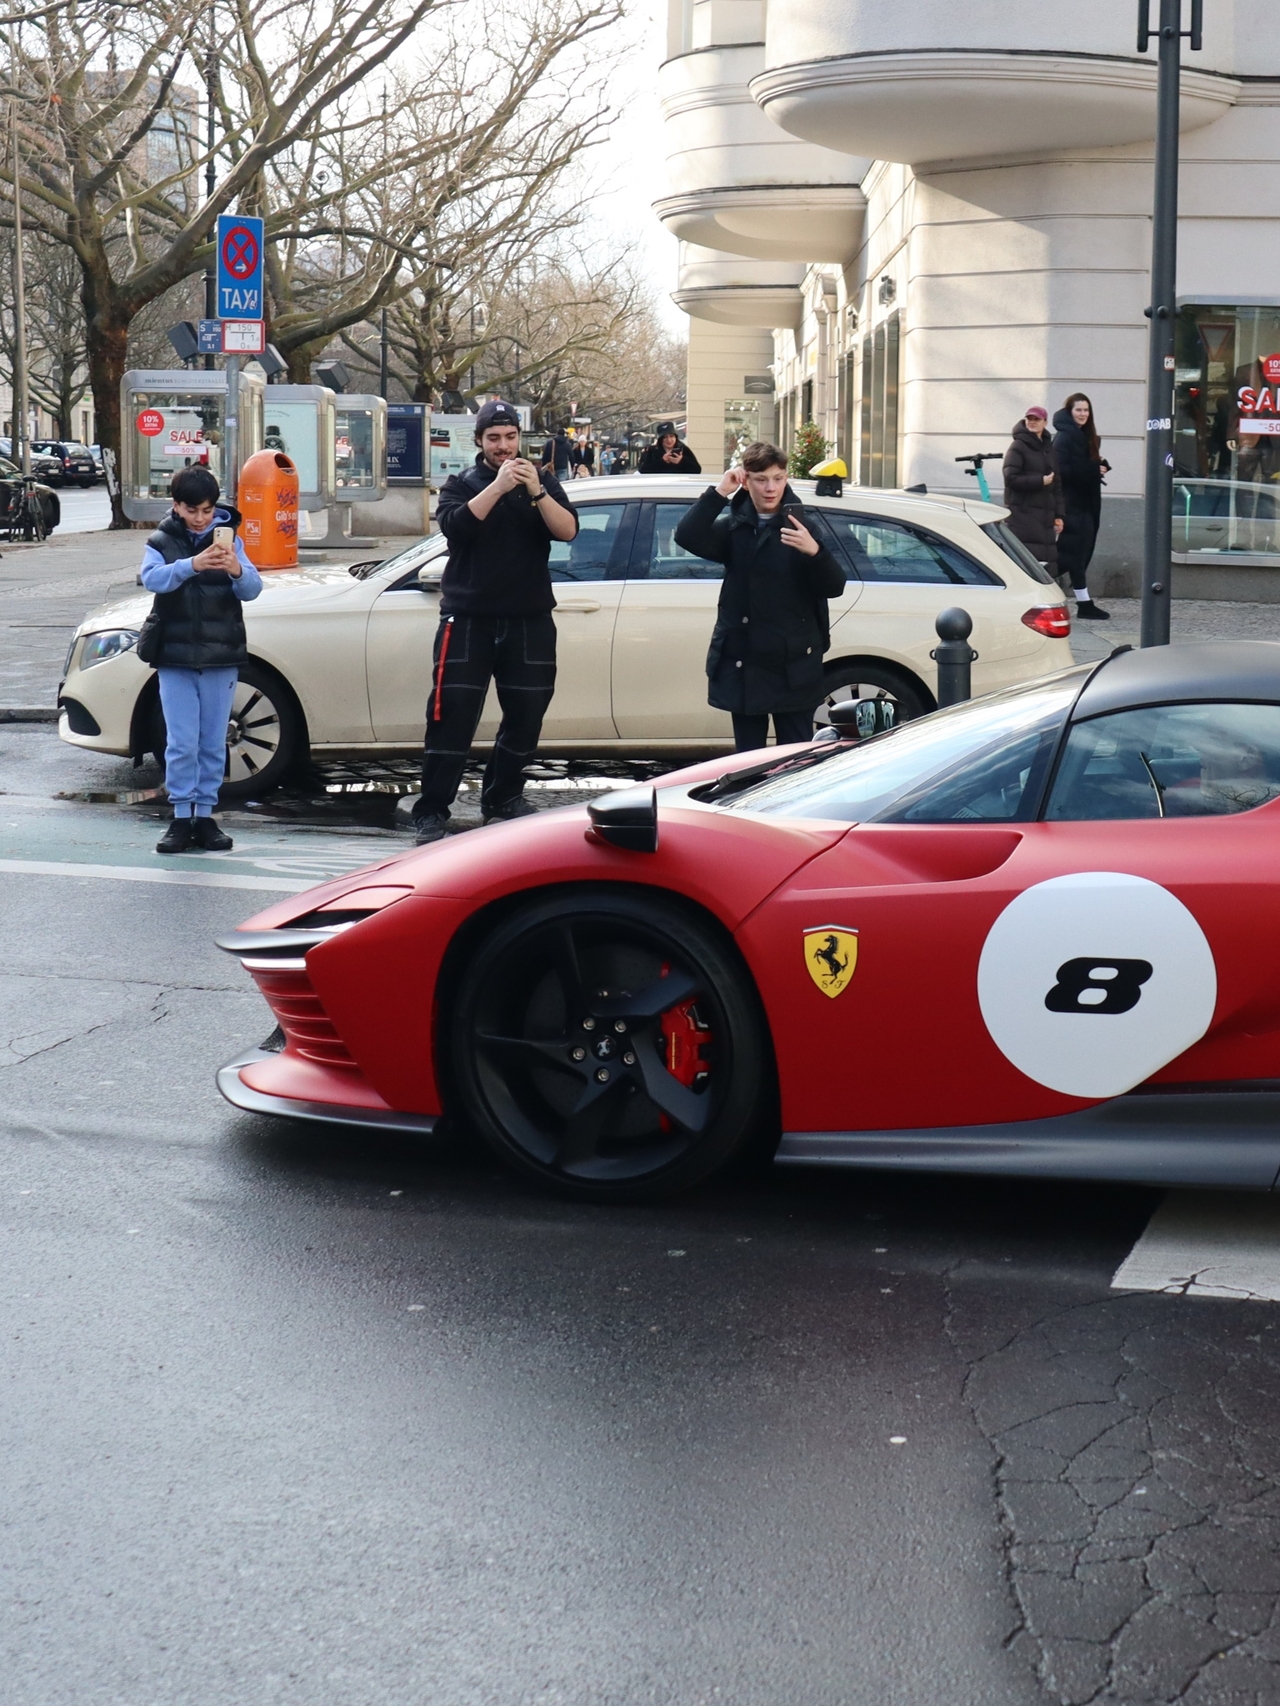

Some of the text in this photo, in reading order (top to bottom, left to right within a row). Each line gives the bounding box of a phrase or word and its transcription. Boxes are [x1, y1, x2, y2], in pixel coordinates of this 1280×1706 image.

[222, 288, 258, 310] TAXI
[169, 430, 203, 442] SALE
[822, 980, 828, 989] S
[1044, 956, 1154, 1015] 8
